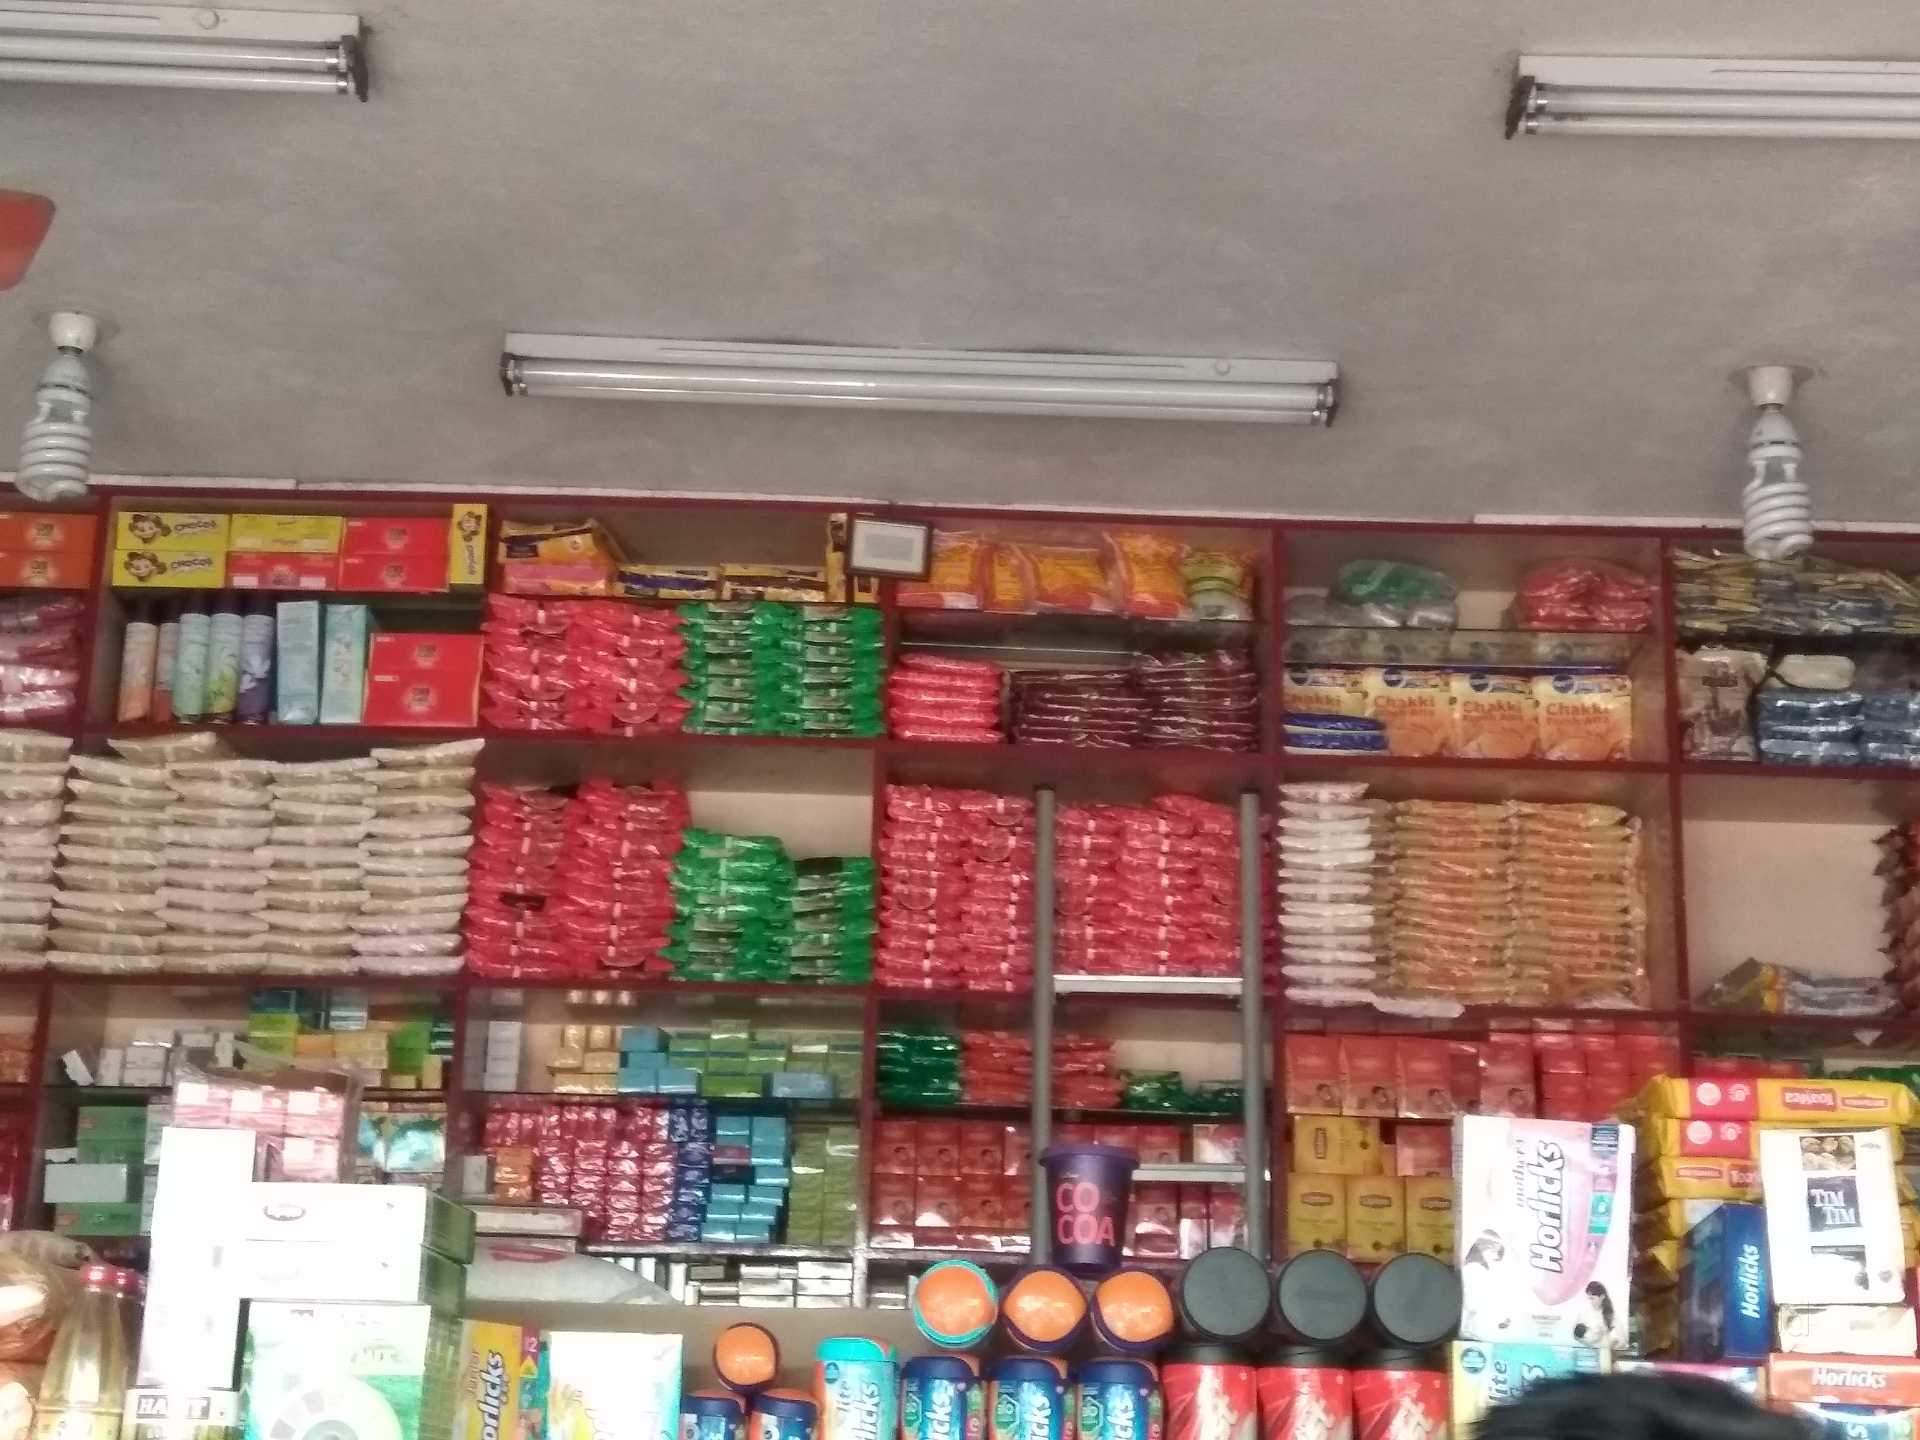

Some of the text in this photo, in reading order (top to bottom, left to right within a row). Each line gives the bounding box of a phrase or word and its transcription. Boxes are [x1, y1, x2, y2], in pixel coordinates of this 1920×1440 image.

[1056, 1181, 1100, 1213] CO
[1529, 1139, 1565, 1274] Horlicks
[1057, 1213, 1115, 1247] COA
[1737, 1243, 1761, 1318] Horlicks
[1811, 1366, 1887, 1389] Horlicks
